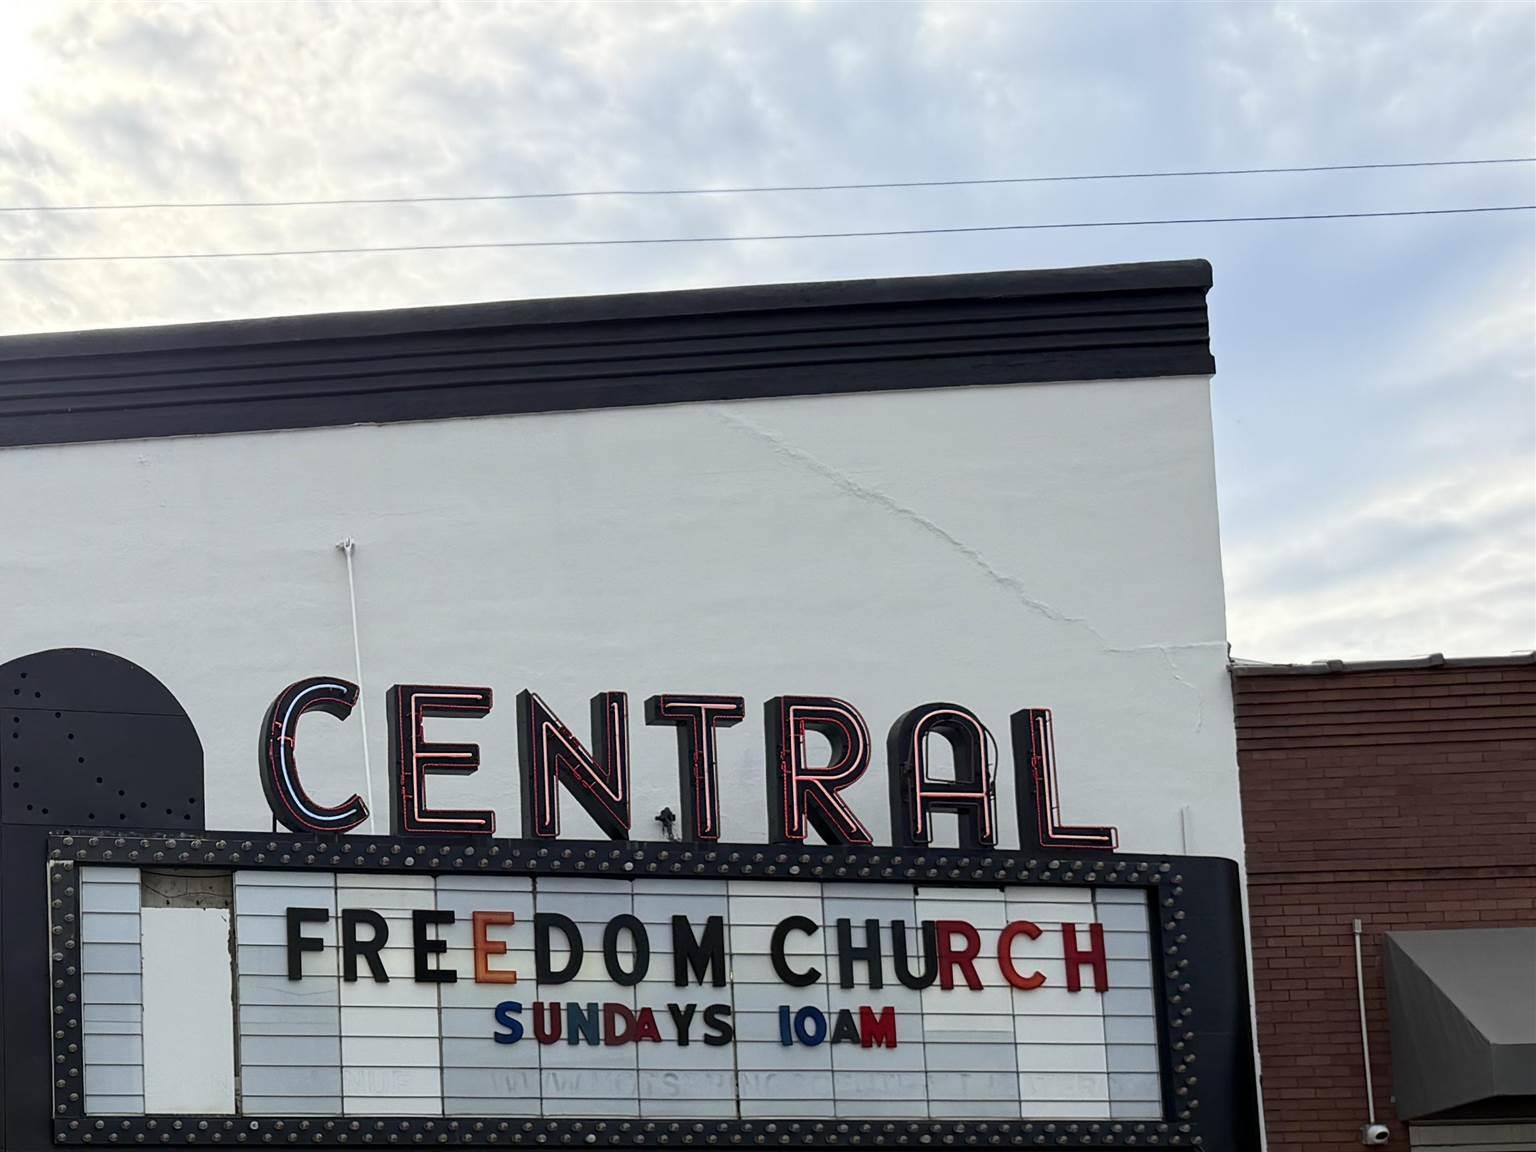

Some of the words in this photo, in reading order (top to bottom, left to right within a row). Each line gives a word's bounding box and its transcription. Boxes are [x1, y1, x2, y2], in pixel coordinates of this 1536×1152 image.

[259, 676, 1119, 848] CENTRAL
[285, 907, 727, 988] FREEDOM
[770, 914, 1110, 993] CHURCH
[492, 1001, 734, 1047] SUNDAYS
